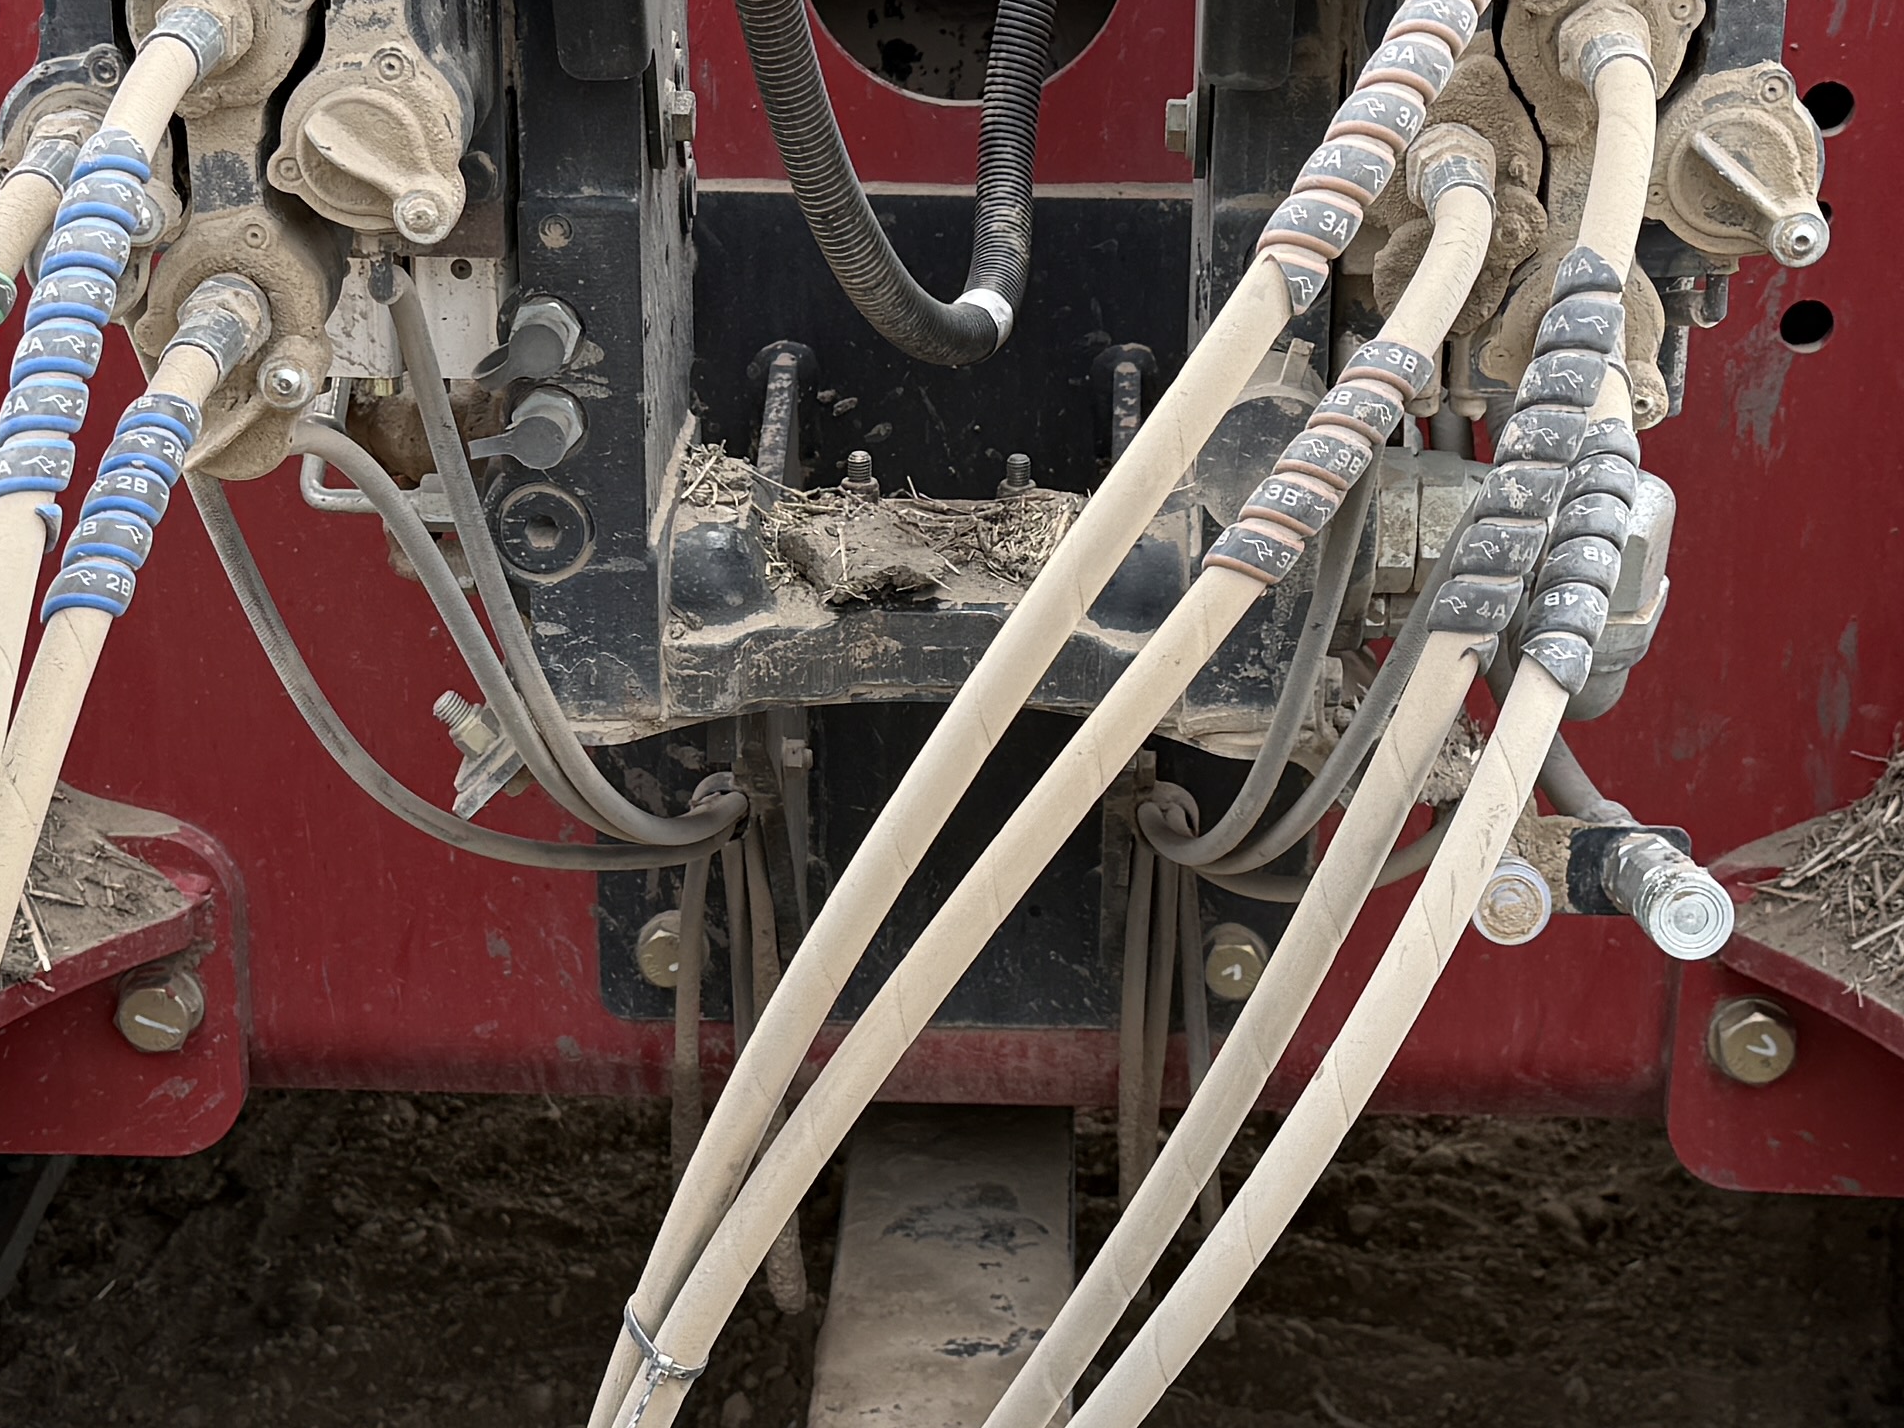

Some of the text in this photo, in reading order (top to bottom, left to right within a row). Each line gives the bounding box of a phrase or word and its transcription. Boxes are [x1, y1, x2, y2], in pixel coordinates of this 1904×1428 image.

[1381, 45, 1415, 65] 3A
[1396, 106, 1419, 132] 3A
[1311, 149, 1342, 170] 3A
[1319, 210, 1349, 241] 3A
[18, 336, 45, 357] 2A
[1385, 348, 1418, 374] 3B
[2, 396, 29, 417] 2A
[1321, 390, 1353, 406] 3B
[163, 440, 184, 466] 2B
[1334, 449, 1363, 474] 3B
[116, 475, 149, 495] 2B
[1265, 484, 1300, 506] 3B
[72, 521, 97, 541] 2B
[106, 573, 133, 597] 2B
[1544, 591, 1579, 607] 4B
[1476, 600, 1507, 620] 4A
